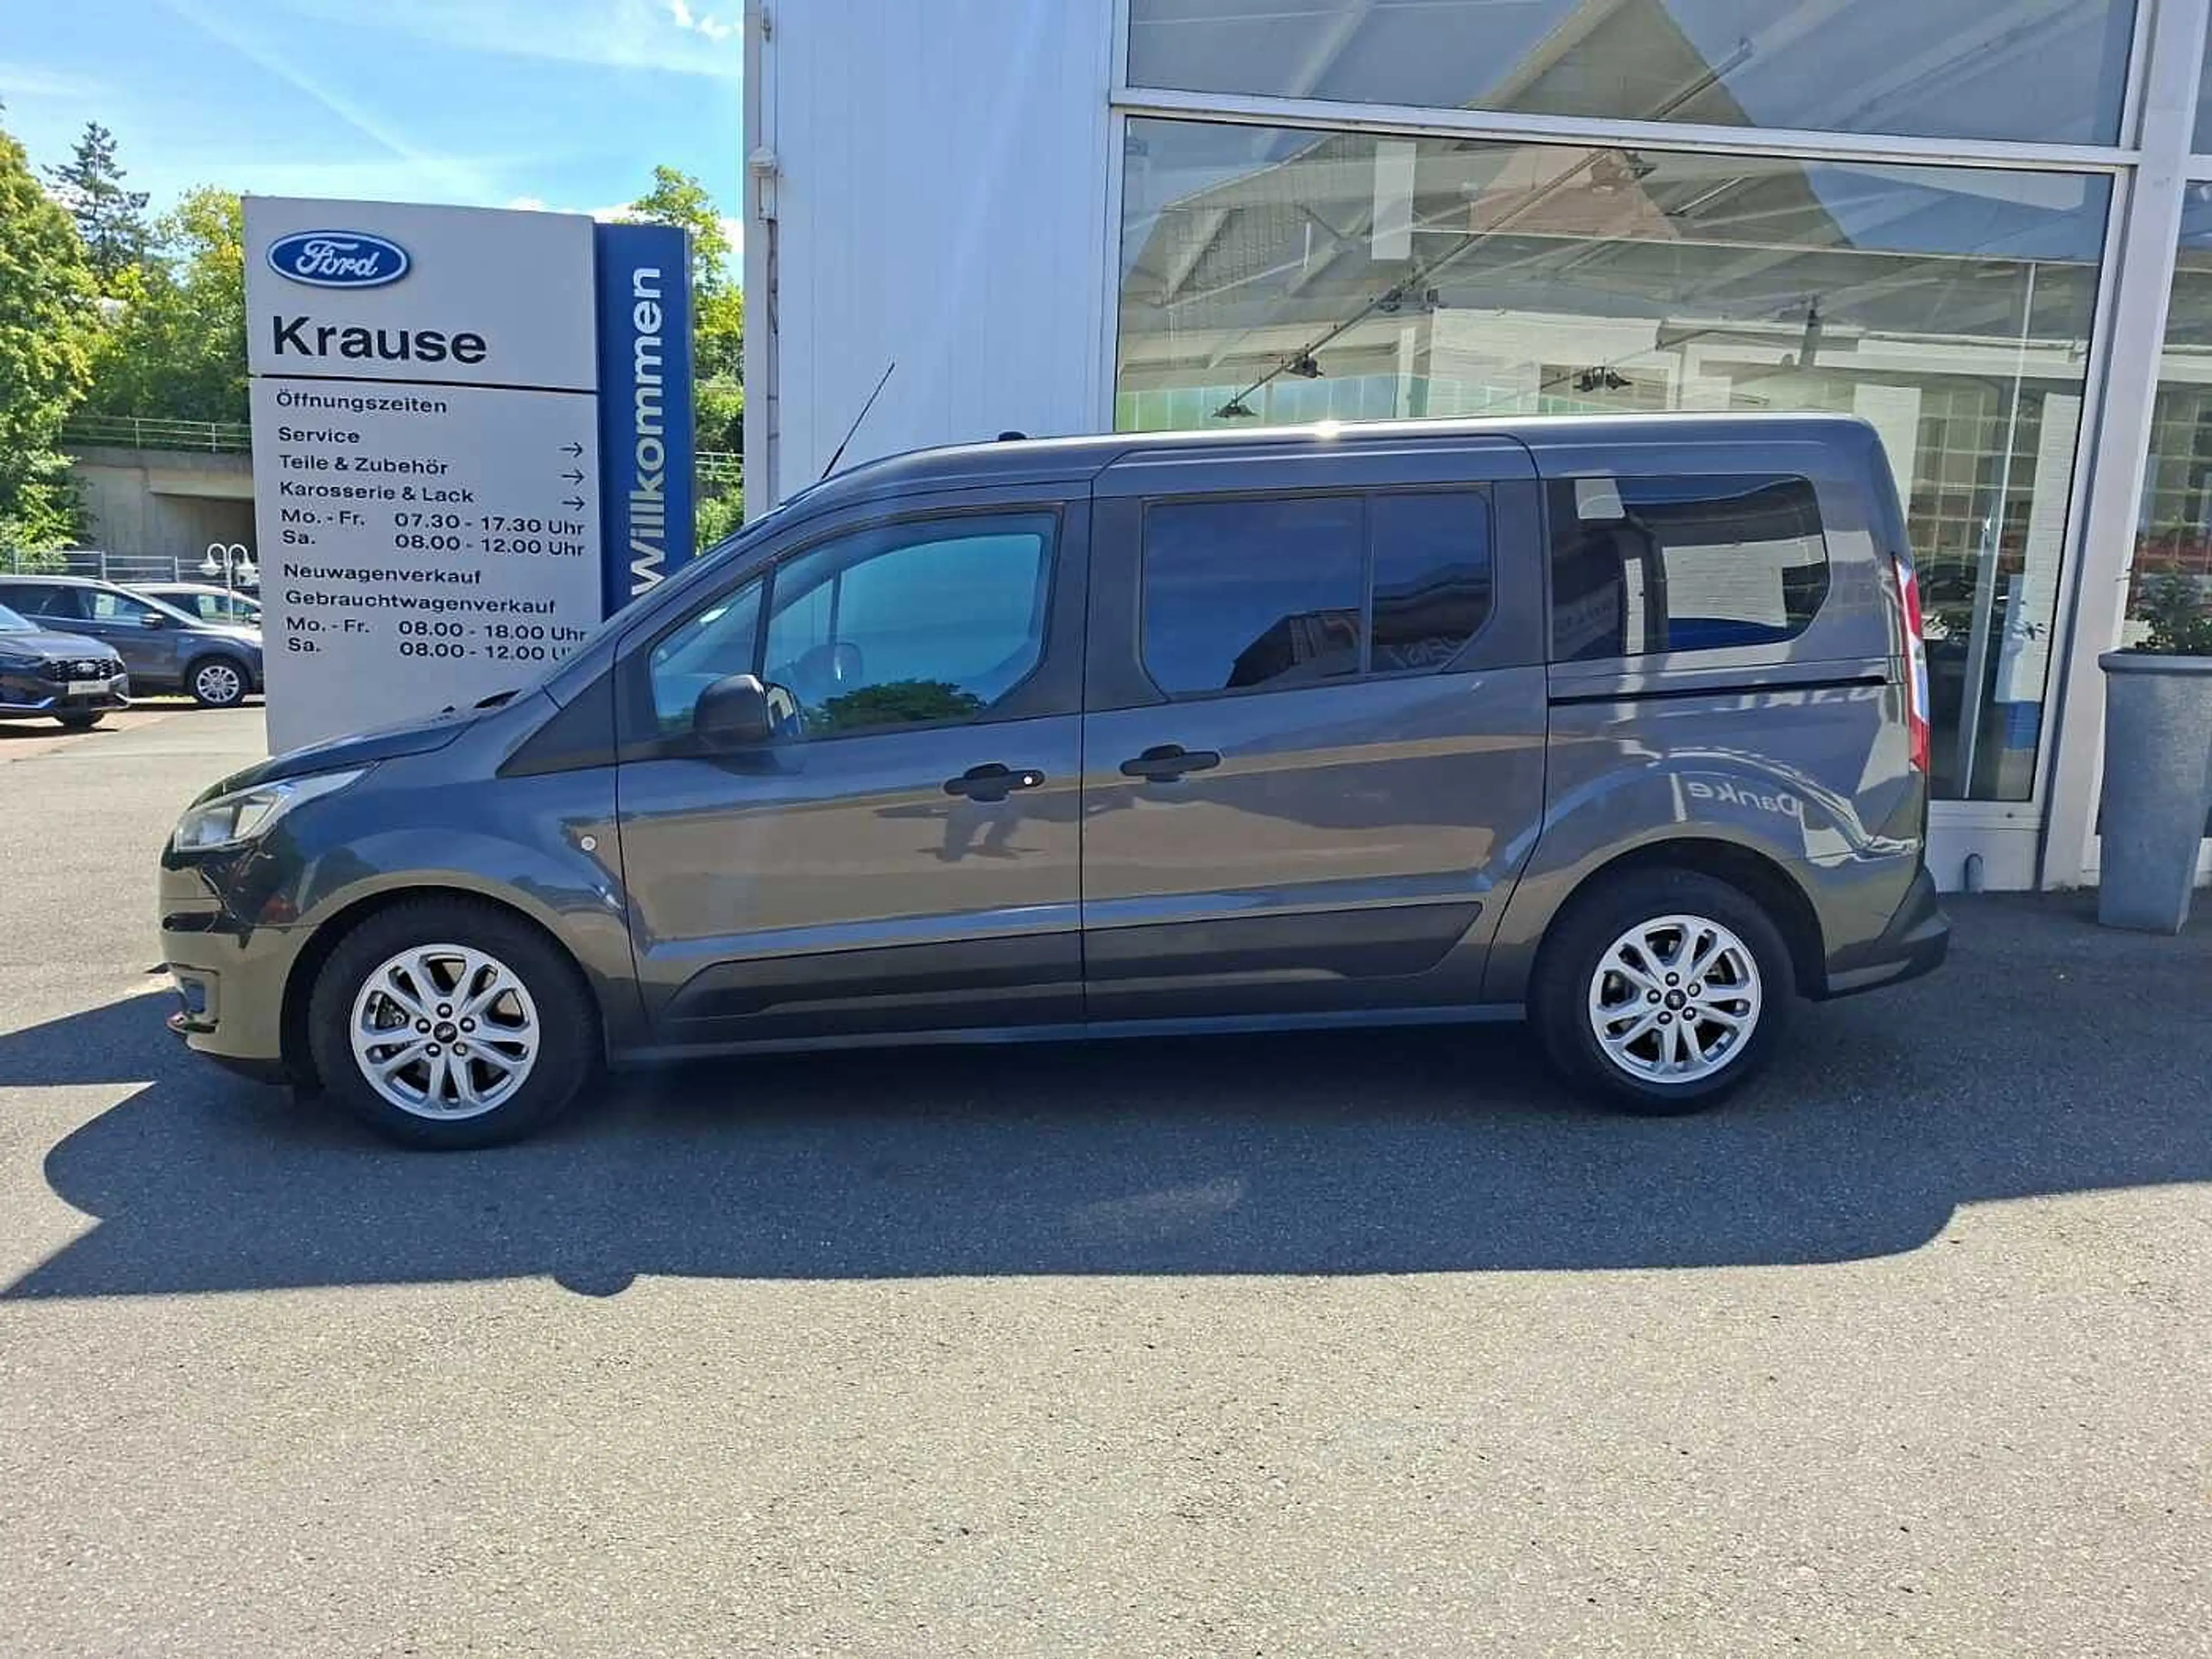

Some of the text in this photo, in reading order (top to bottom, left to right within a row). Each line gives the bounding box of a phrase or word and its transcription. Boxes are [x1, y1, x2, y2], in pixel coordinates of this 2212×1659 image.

[296, 240, 380, 276] Ford
[273, 316, 486, 364] Krause
[276, 389, 446, 414] Öffnungszeiten
[278, 427, 360, 443] Service
[630, 268, 665, 594] Willkommen
[280, 455, 449, 475] Teile & Zubehör
[280, 482, 474, 503] Karosserie & Lack
[281, 509, 321, 524] Mo.
[339, 510, 365, 525] Fr.
[395, 513, 460, 529] 07.30
[481, 517, 541, 533] 17.30
[549, 520, 585, 535] Uhr
[282, 530, 316, 544] Sa.
[395, 535, 460, 550] 08.00
[480, 539, 541, 554] 12.00
[549, 541, 585, 556] Uhr
[283, 563, 480, 584] Neuwagenverkauf
[286, 590, 556, 615] Gebrauchtwagenverkauf
[287, 617, 326, 632] Mo.
[344, 619, 370, 634] Fr.
[399, 621, 463, 637] 08.00
[484, 626, 544, 640] 18.00
[551, 626, 586, 641] Uhr
[288, 638, 320, 653] Sa.
[399, 642, 463, 658] 08.00
[484, 646, 544, 660] 12.00
